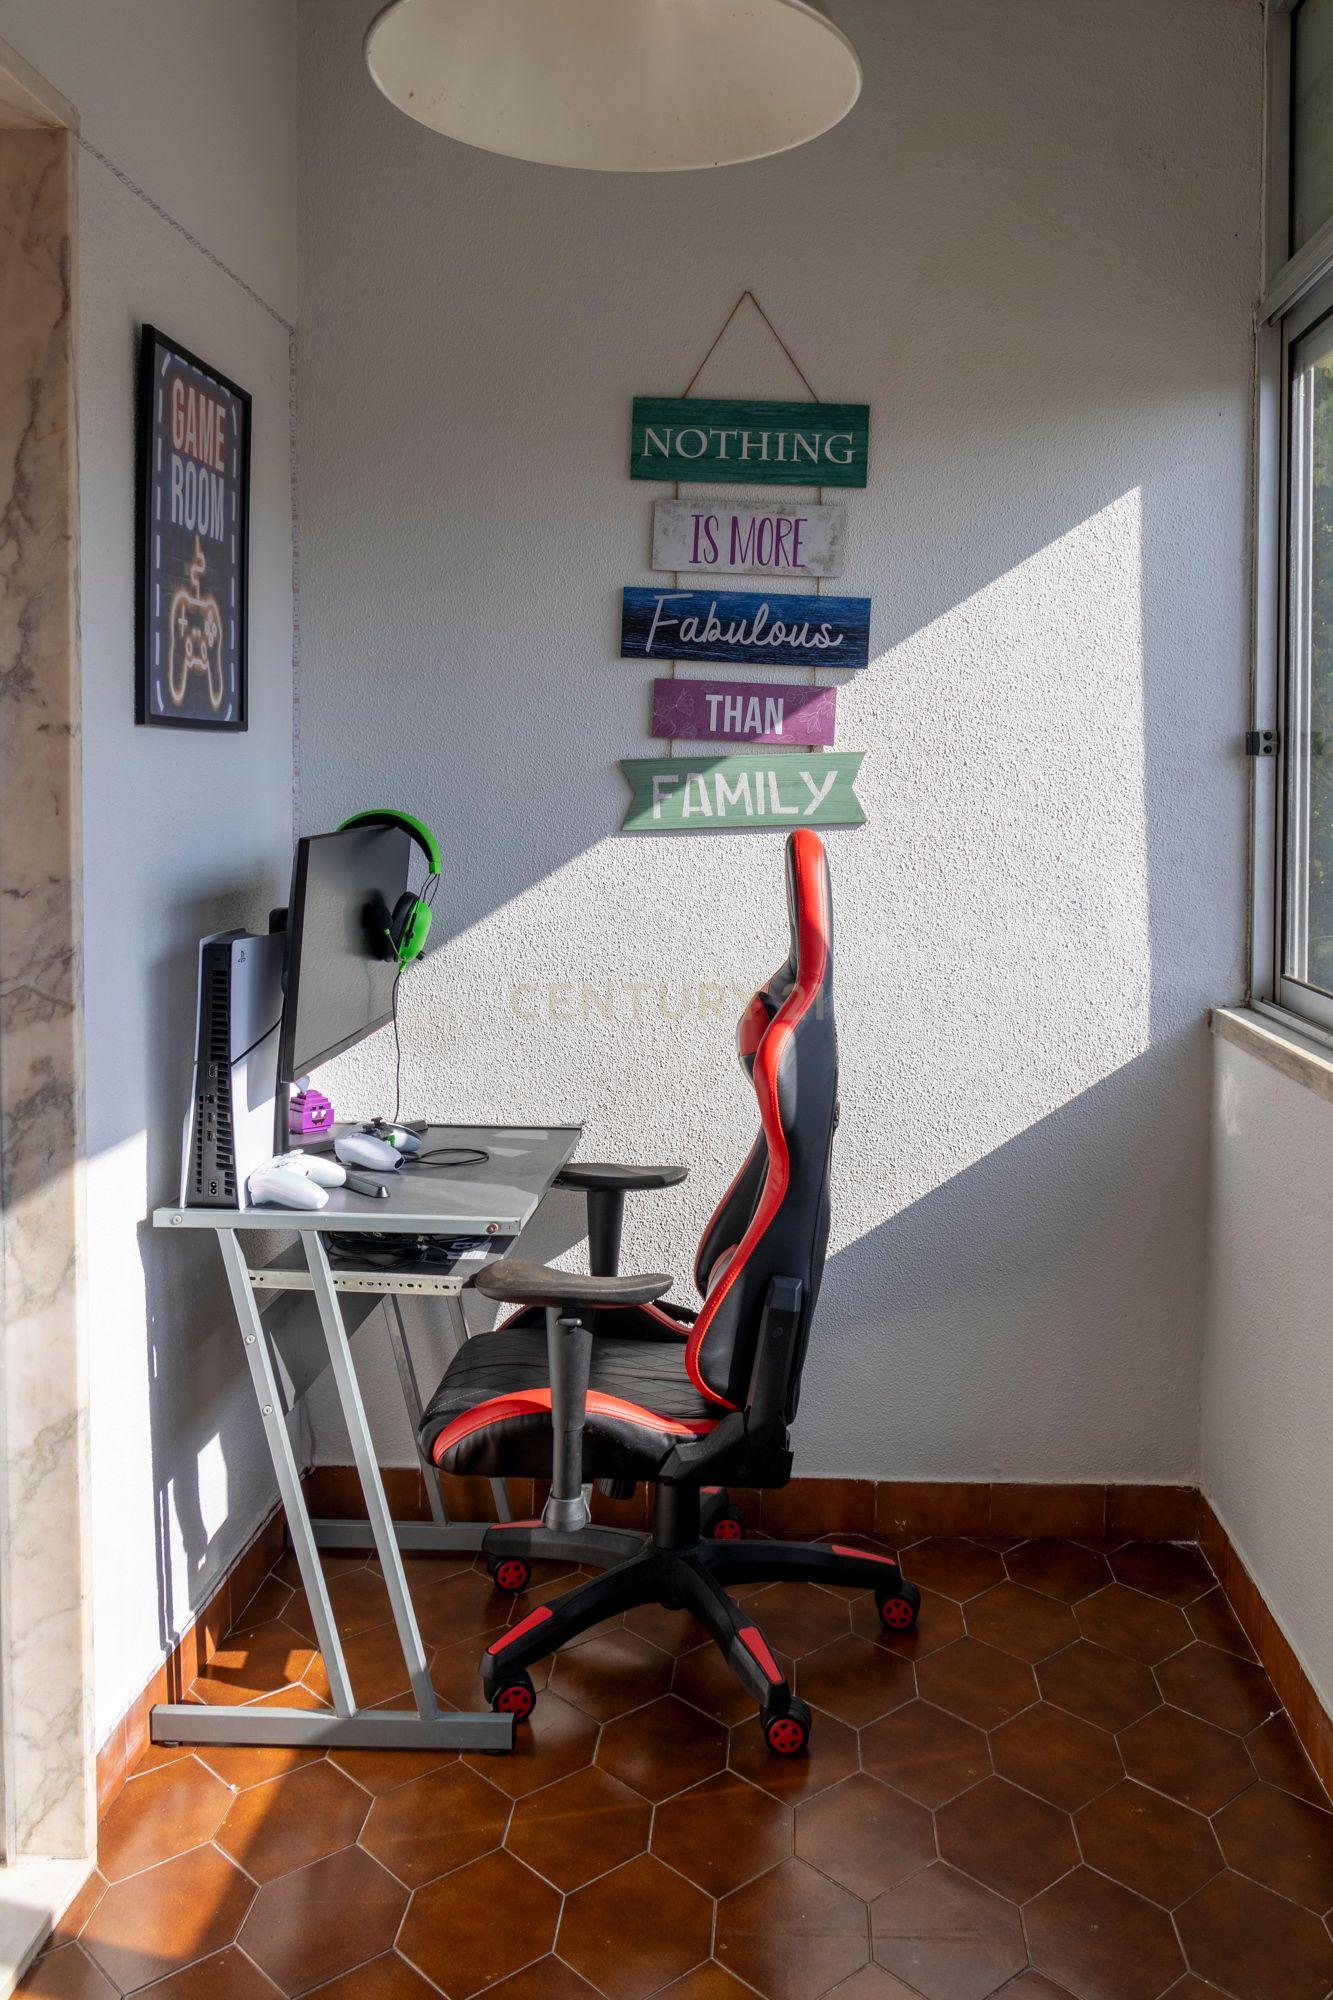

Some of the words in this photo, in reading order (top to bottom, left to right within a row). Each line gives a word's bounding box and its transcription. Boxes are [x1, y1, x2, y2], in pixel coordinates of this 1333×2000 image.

[172, 377, 226, 473] GAME
[641, 427, 856, 464] NOTHING
[171, 453, 225, 542] ROOM
[688, 514, 719, 564] IS
[729, 516, 808, 567] MORE
[645, 593, 843, 652] Fabulous
[706, 694, 784, 734] THAN
[651, 770, 838, 819] FAMILY
